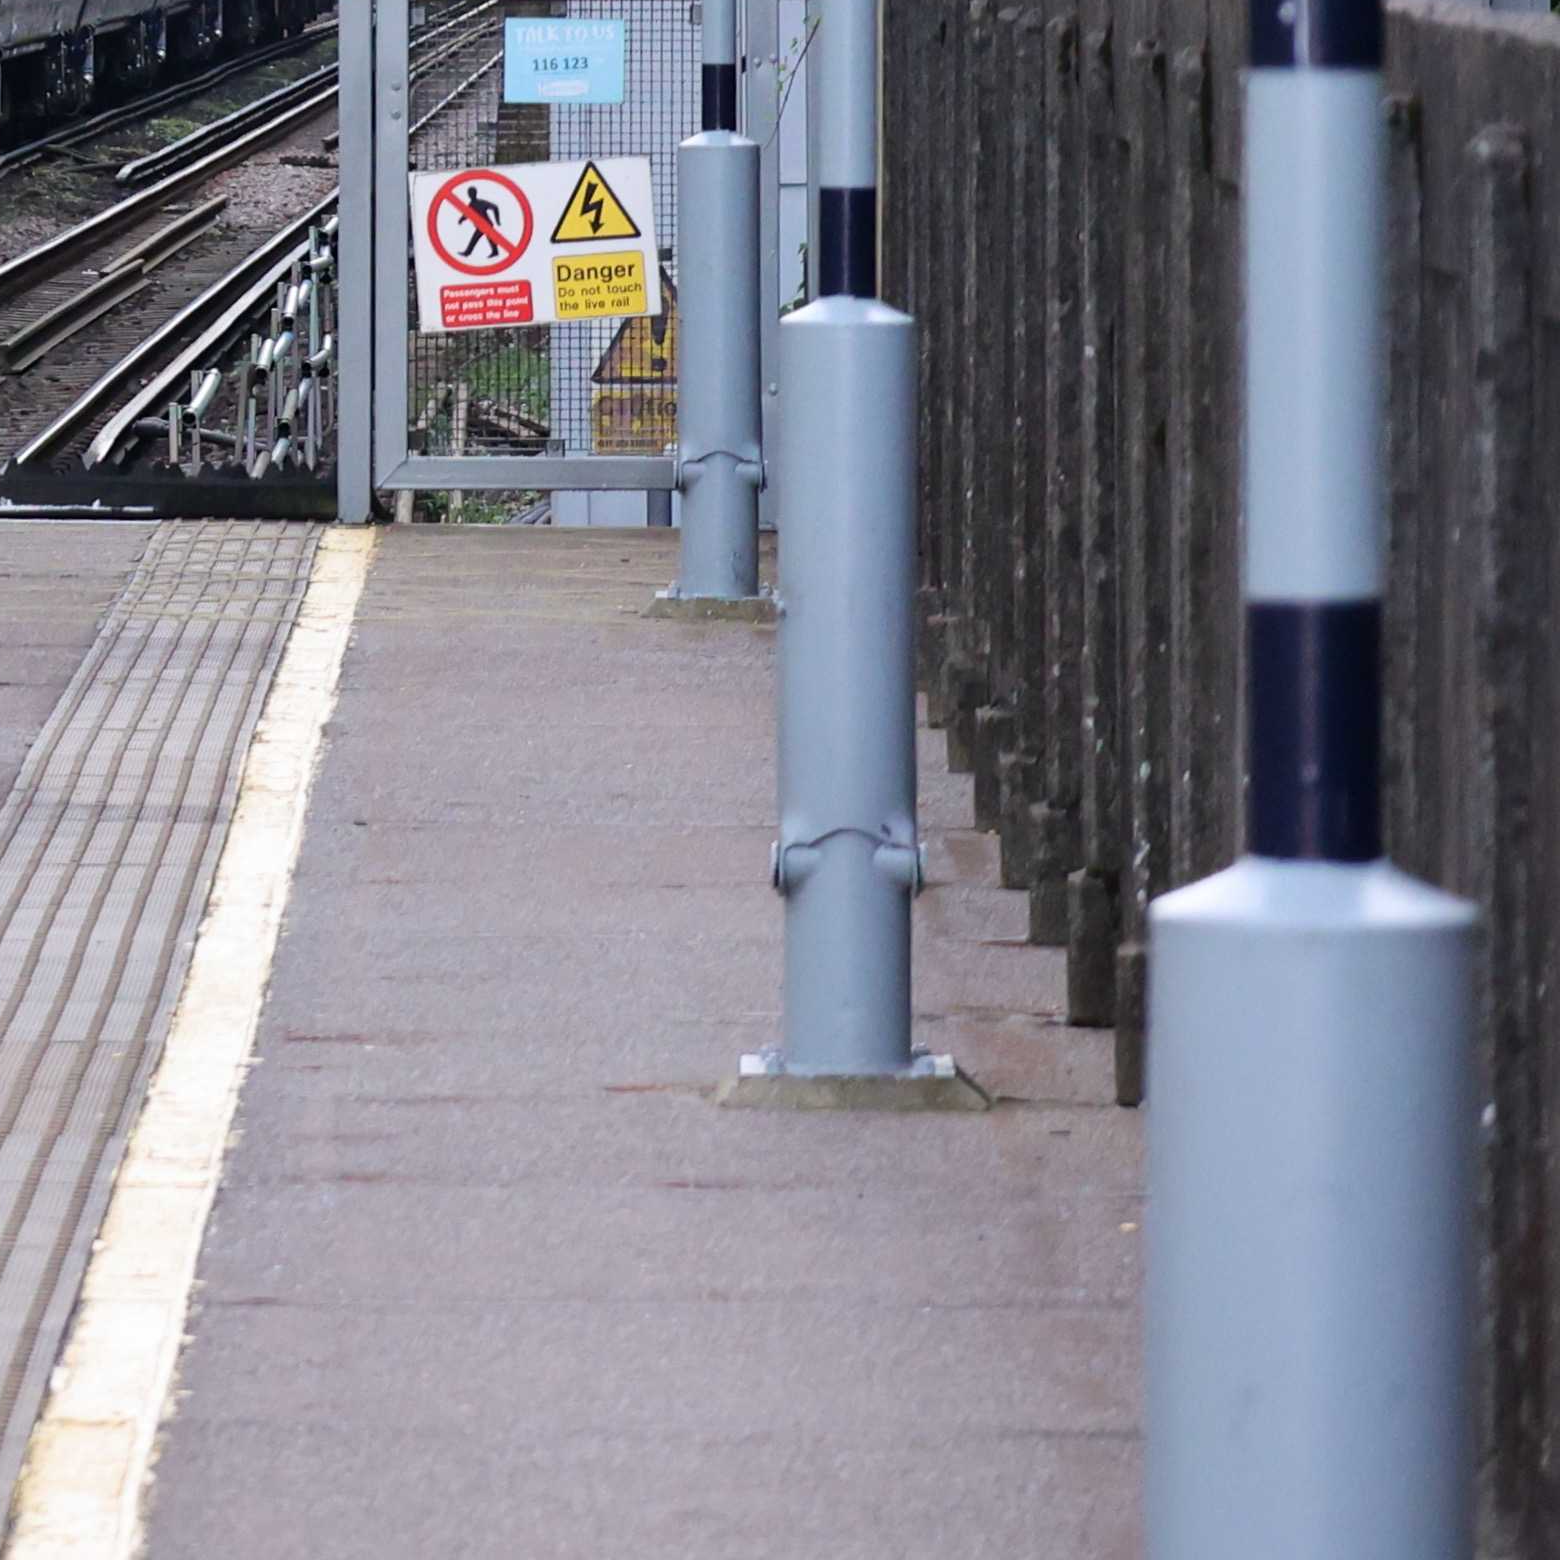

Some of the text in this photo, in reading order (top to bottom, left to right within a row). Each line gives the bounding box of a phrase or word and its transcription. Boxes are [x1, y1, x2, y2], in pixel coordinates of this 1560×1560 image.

[516, 23, 616, 45] TALK TO US
[532, 57, 589, 71] 116 123
[556, 263, 635, 283] Danger
[558, 282, 642, 298] Do not touch
[560, 296, 630, 311] the live rail
